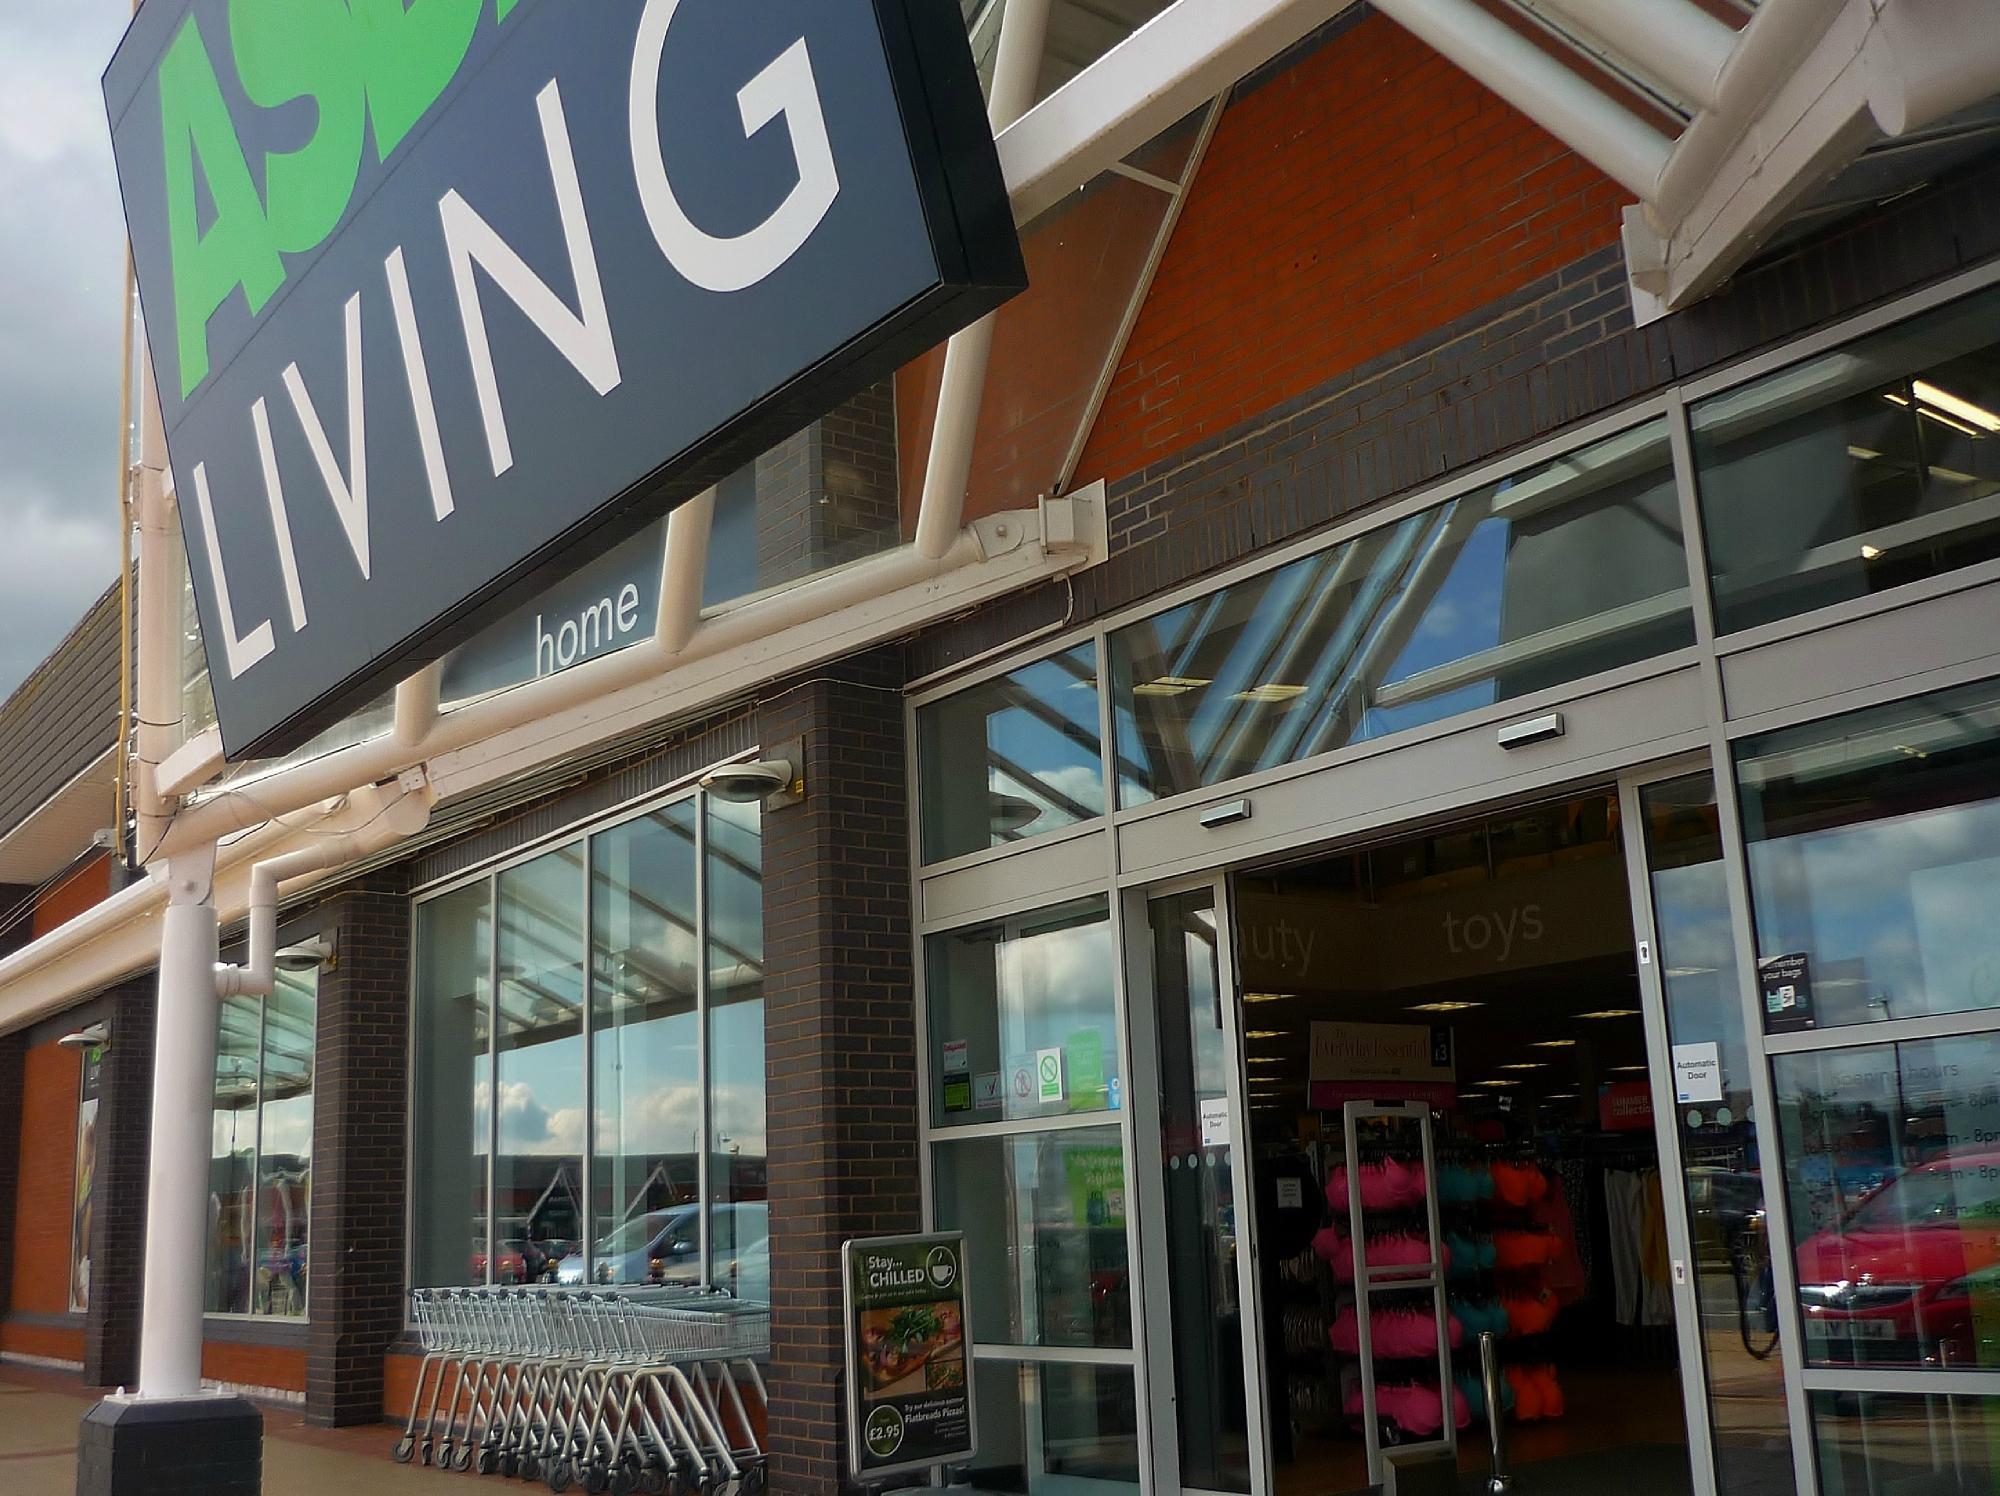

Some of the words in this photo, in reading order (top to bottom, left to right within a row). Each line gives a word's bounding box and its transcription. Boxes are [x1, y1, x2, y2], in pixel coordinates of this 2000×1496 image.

[158, 0, 521, 402] AS
[194, 0, 841, 680] LIVING
[536, 583, 639, 678] home
[1442, 904, 1544, 962] toys
[1677, 1060, 1716, 1069] Automatic
[1687, 1071, 1707, 1080] Door
[868, 1255, 903, 1271] Stay...
[870, 1268, 926, 1287] CHILLED
[869, 1423, 901, 1441] £2.95
